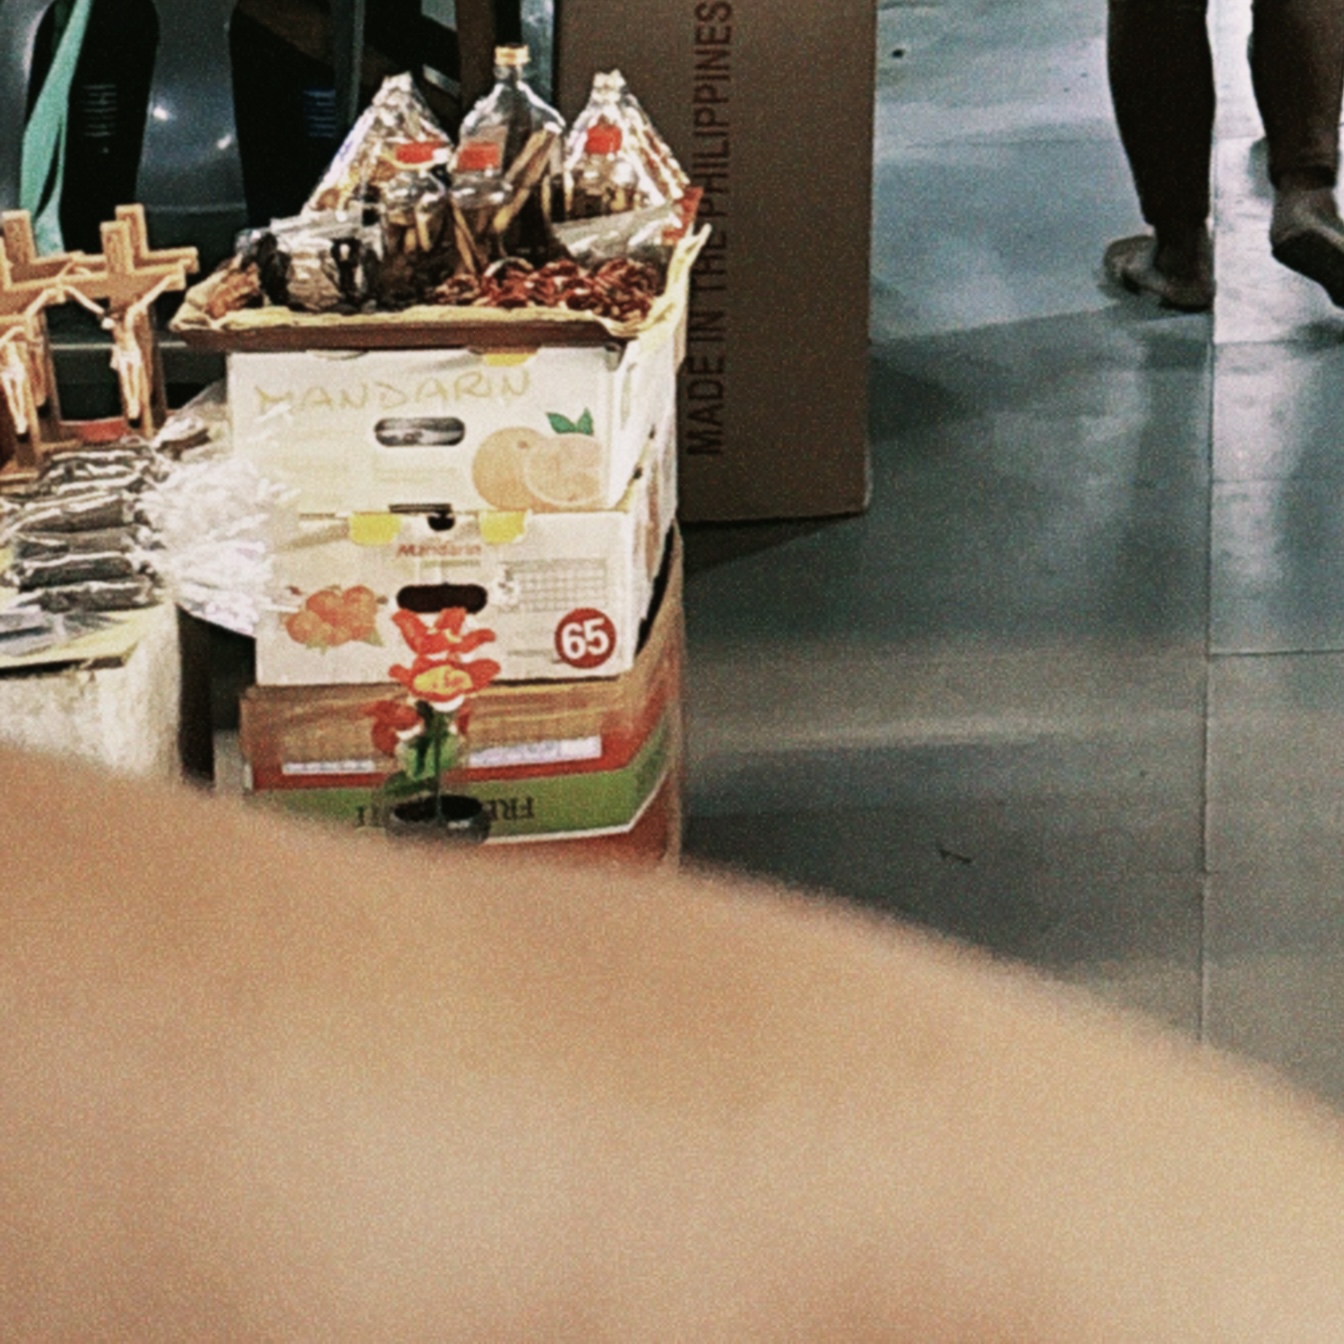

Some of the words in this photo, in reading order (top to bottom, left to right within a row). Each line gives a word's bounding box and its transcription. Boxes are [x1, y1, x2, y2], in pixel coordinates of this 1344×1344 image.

[692, 0, 733, 218] PHILIPPINES
[689, 234, 728, 303] THE
[688, 313, 725, 354] IN
[254, 369, 531, 411] MANDARIN
[687, 356, 725, 457] MADE
[561, 617, 609, 660] 65
